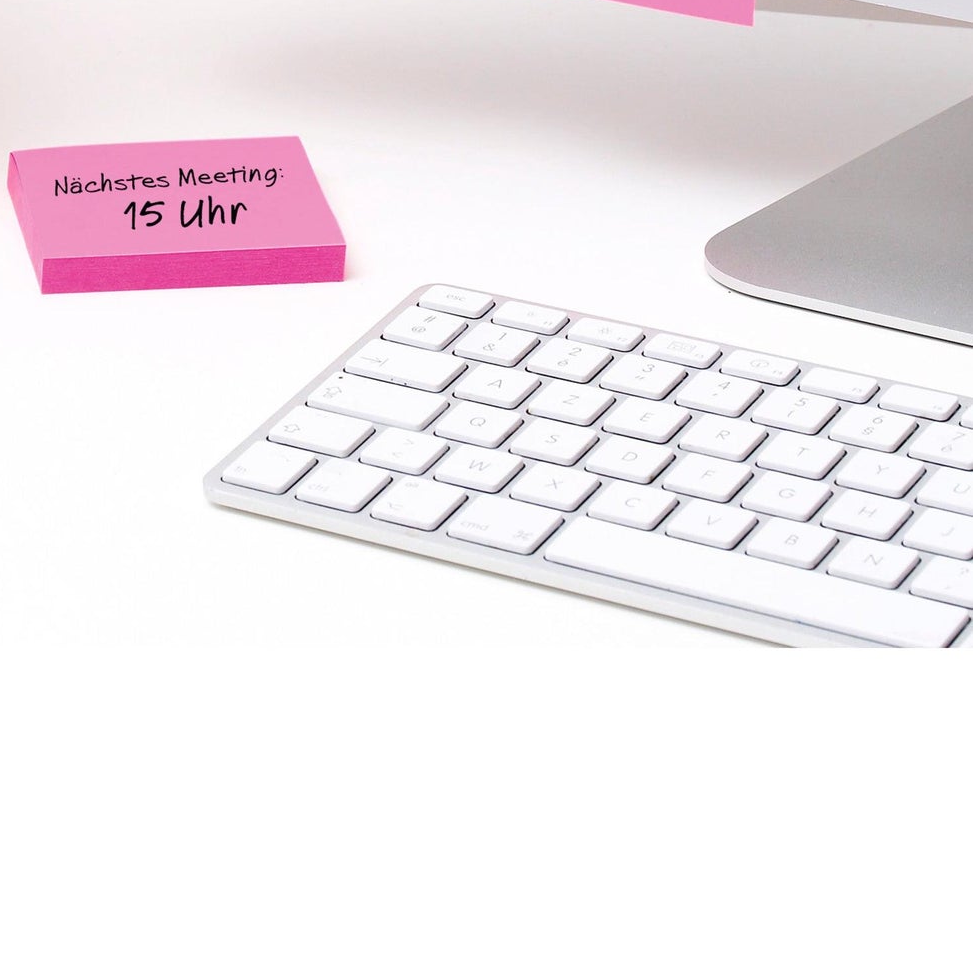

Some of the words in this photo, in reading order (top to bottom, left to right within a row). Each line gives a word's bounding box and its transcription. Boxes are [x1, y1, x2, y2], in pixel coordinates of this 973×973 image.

[54, 172, 171, 197] Nächstes
[178, 165, 285, 188] Meeting:
[123, 200, 165, 231] 15
[179, 195, 248, 229] Uhr
